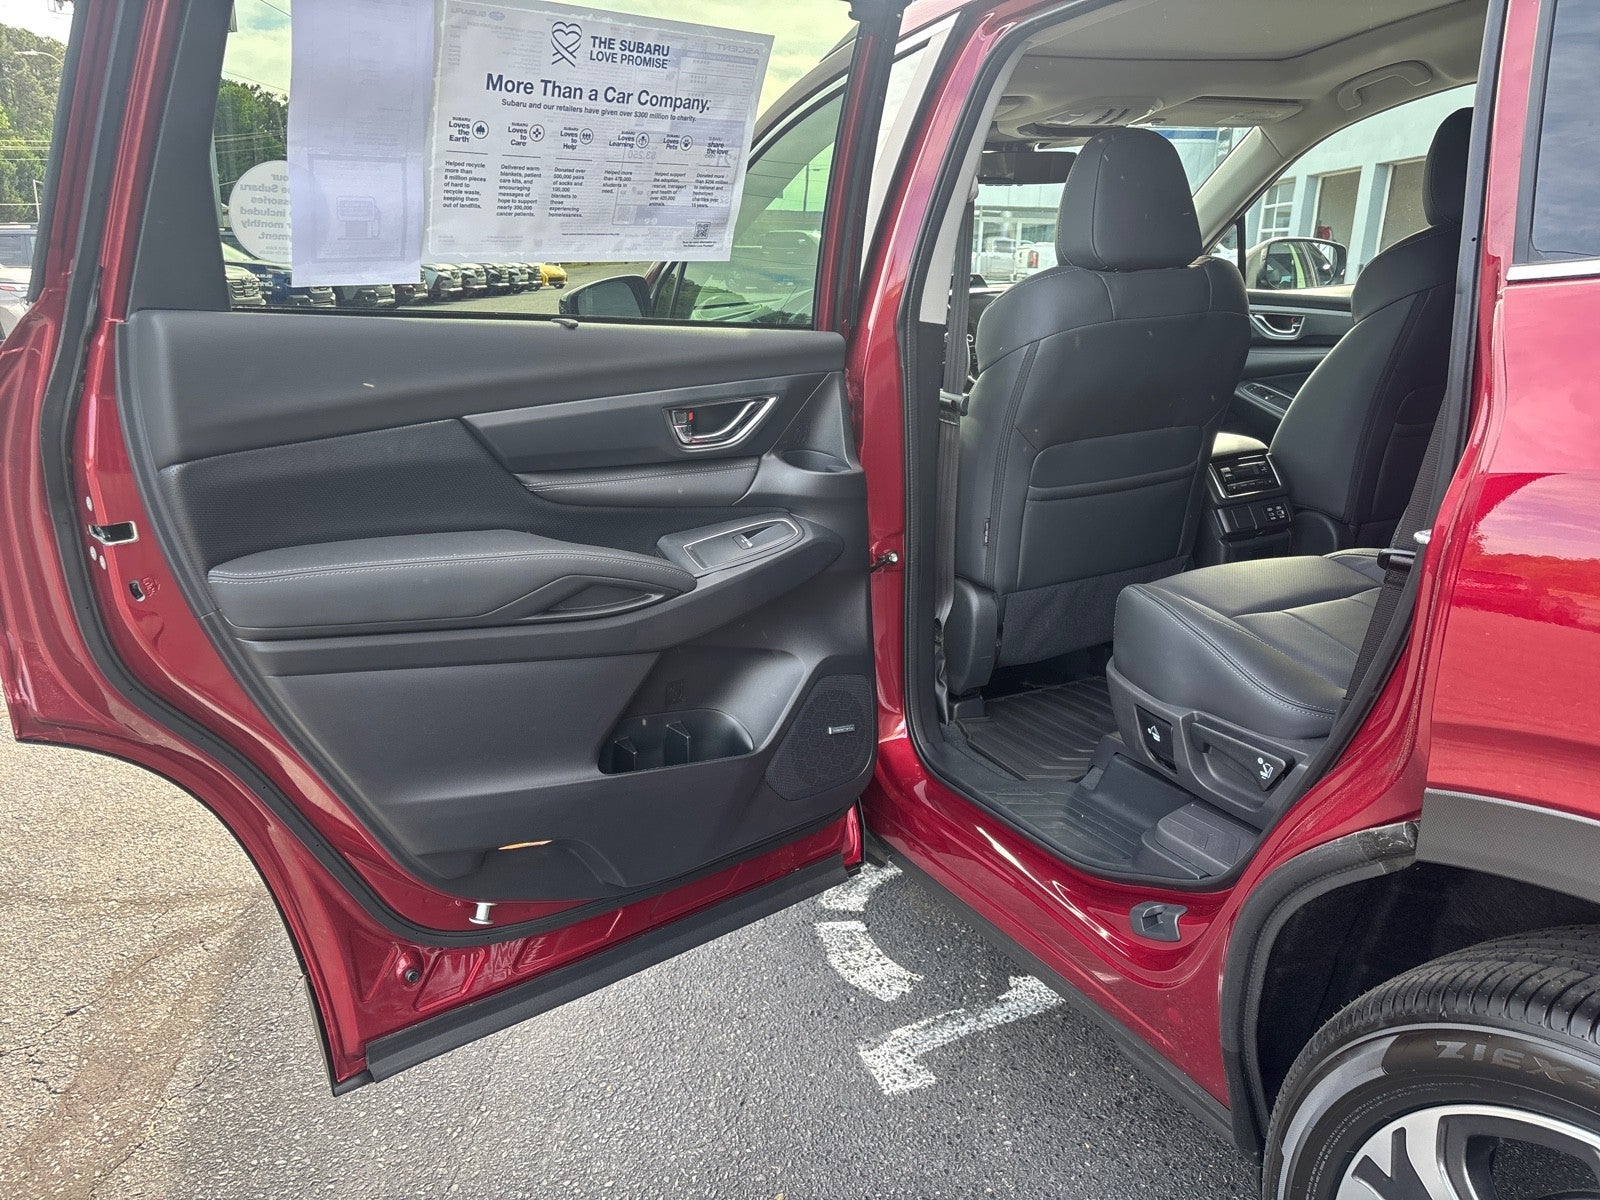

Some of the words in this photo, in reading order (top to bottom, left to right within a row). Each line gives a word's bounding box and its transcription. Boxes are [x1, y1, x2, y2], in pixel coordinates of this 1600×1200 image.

[590, 36, 615, 50] THE
[620, 39, 670, 56] SUBARU
[590, 51, 617, 63] LOVE
[620, 53, 668, 69] PROMISE
[486, 73, 534, 94] More
[540, 79, 583, 100] Than
[588, 88, 598, 101] a
[603, 86, 633, 104] Car
[637, 89, 710, 114] Company.
[502, 98, 527, 108] Subaru
[556, 104, 583, 113] retailers
[584, 106, 599, 114] have
[601, 108, 618, 117] given
[634, 110, 648, 119] $300
[650, 112, 669, 120] million
[677, 114, 696, 123] charity.
[1436, 1040, 1573, 1084] ZIEX
